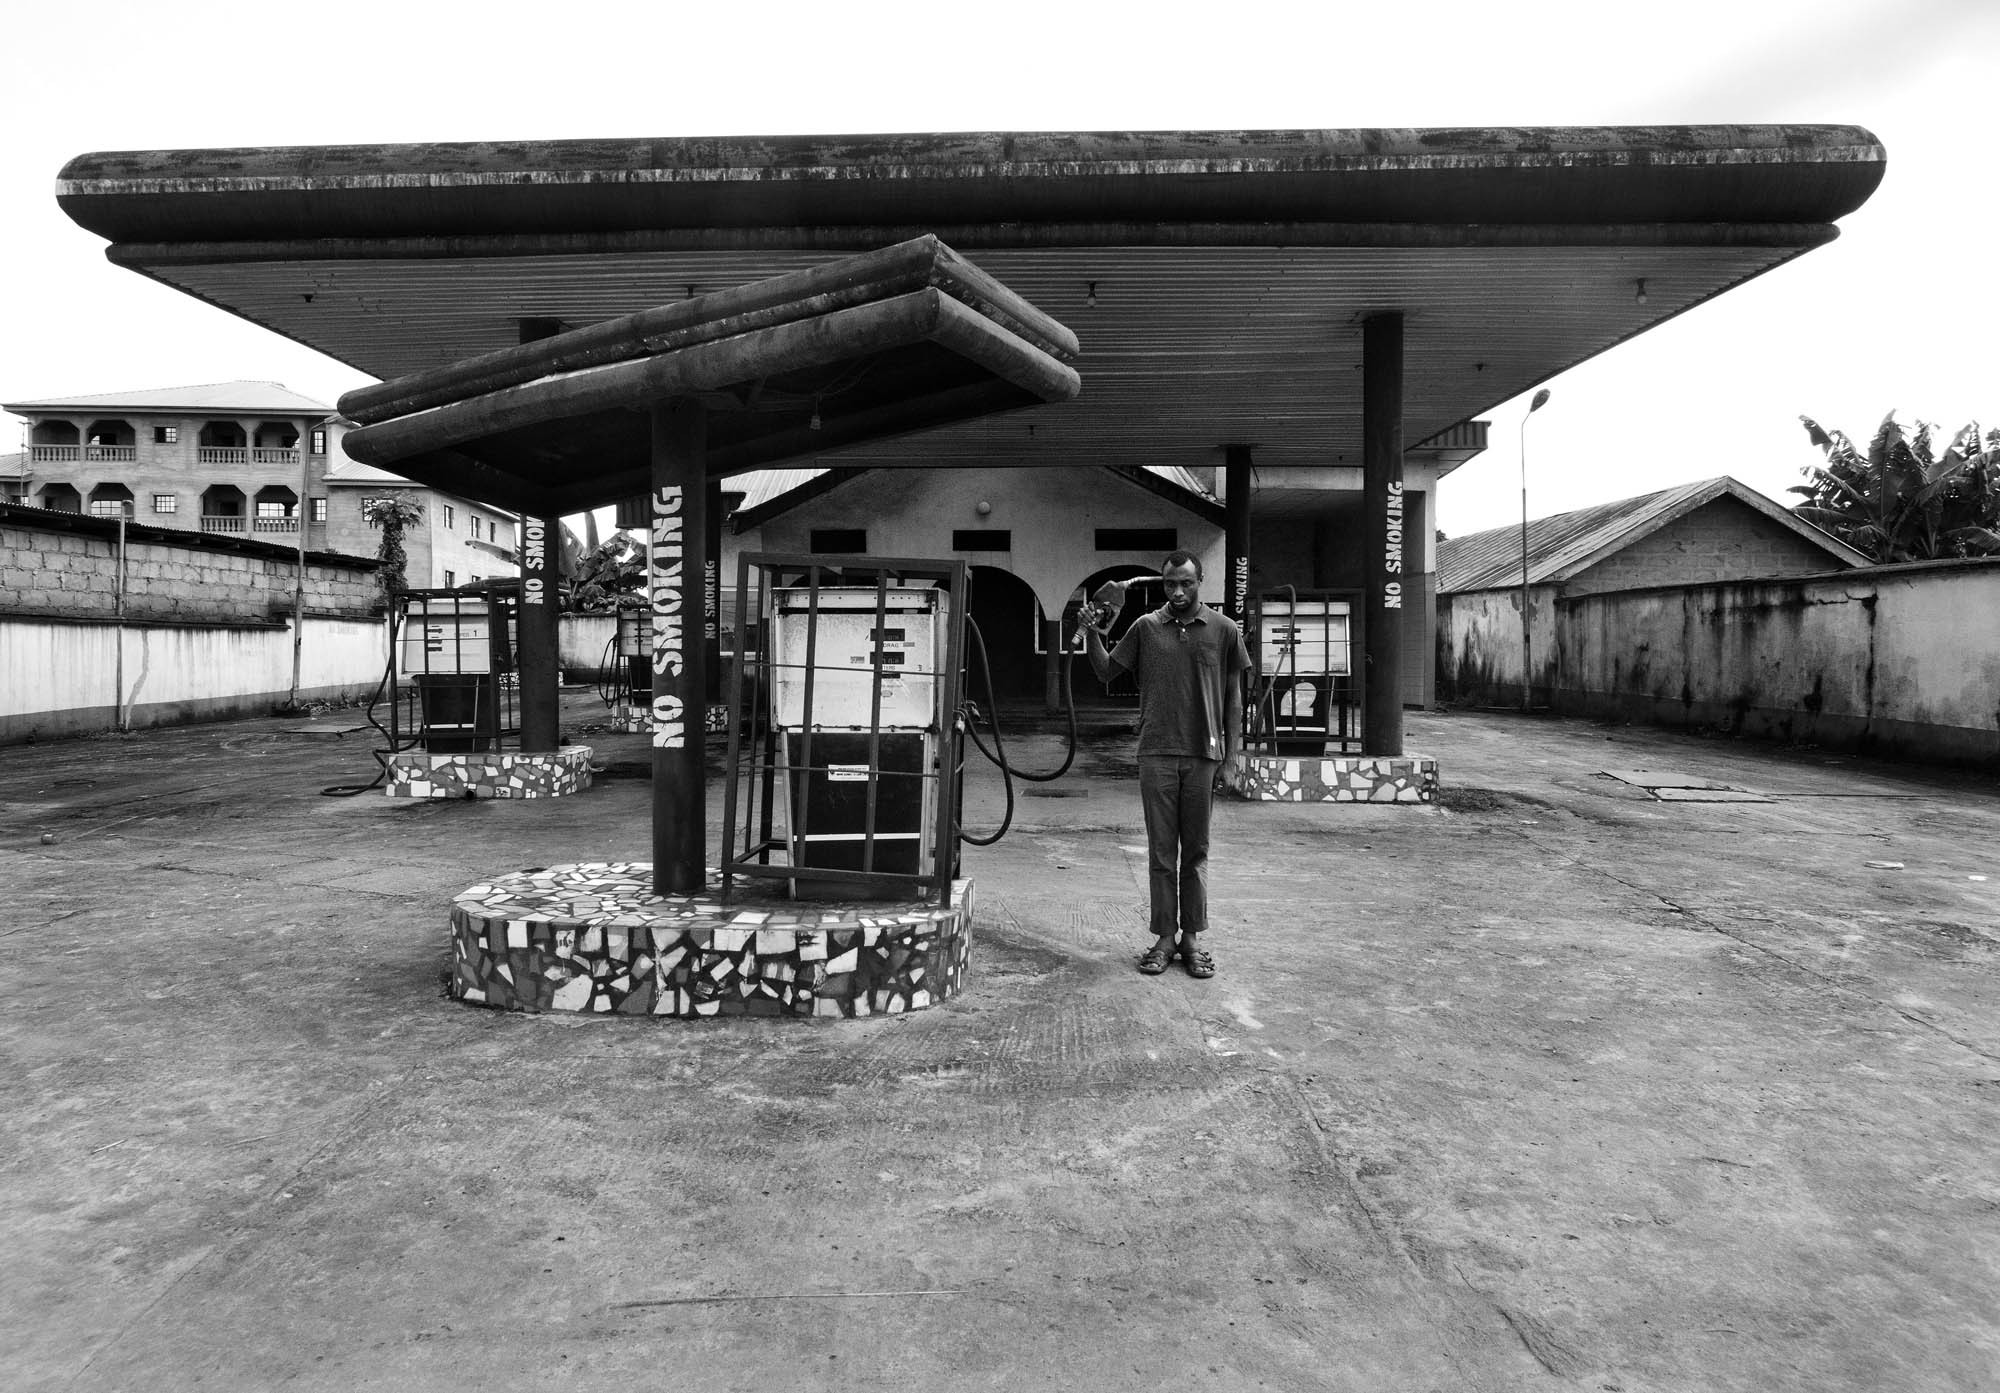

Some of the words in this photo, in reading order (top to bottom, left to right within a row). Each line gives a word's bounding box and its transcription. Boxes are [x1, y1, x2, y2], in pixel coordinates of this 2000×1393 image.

[525, 515, 545, 571] SMOK
[1385, 481, 1403, 574] SMOKING
[525, 578, 544, 604] NO
[652, 485, 683, 677] SMOKING
[704, 560, 716, 617] SMOKING
[1384, 582, 1401, 609] NO
[704, 623, 716, 639] NO
[652, 694, 684, 748] NO
